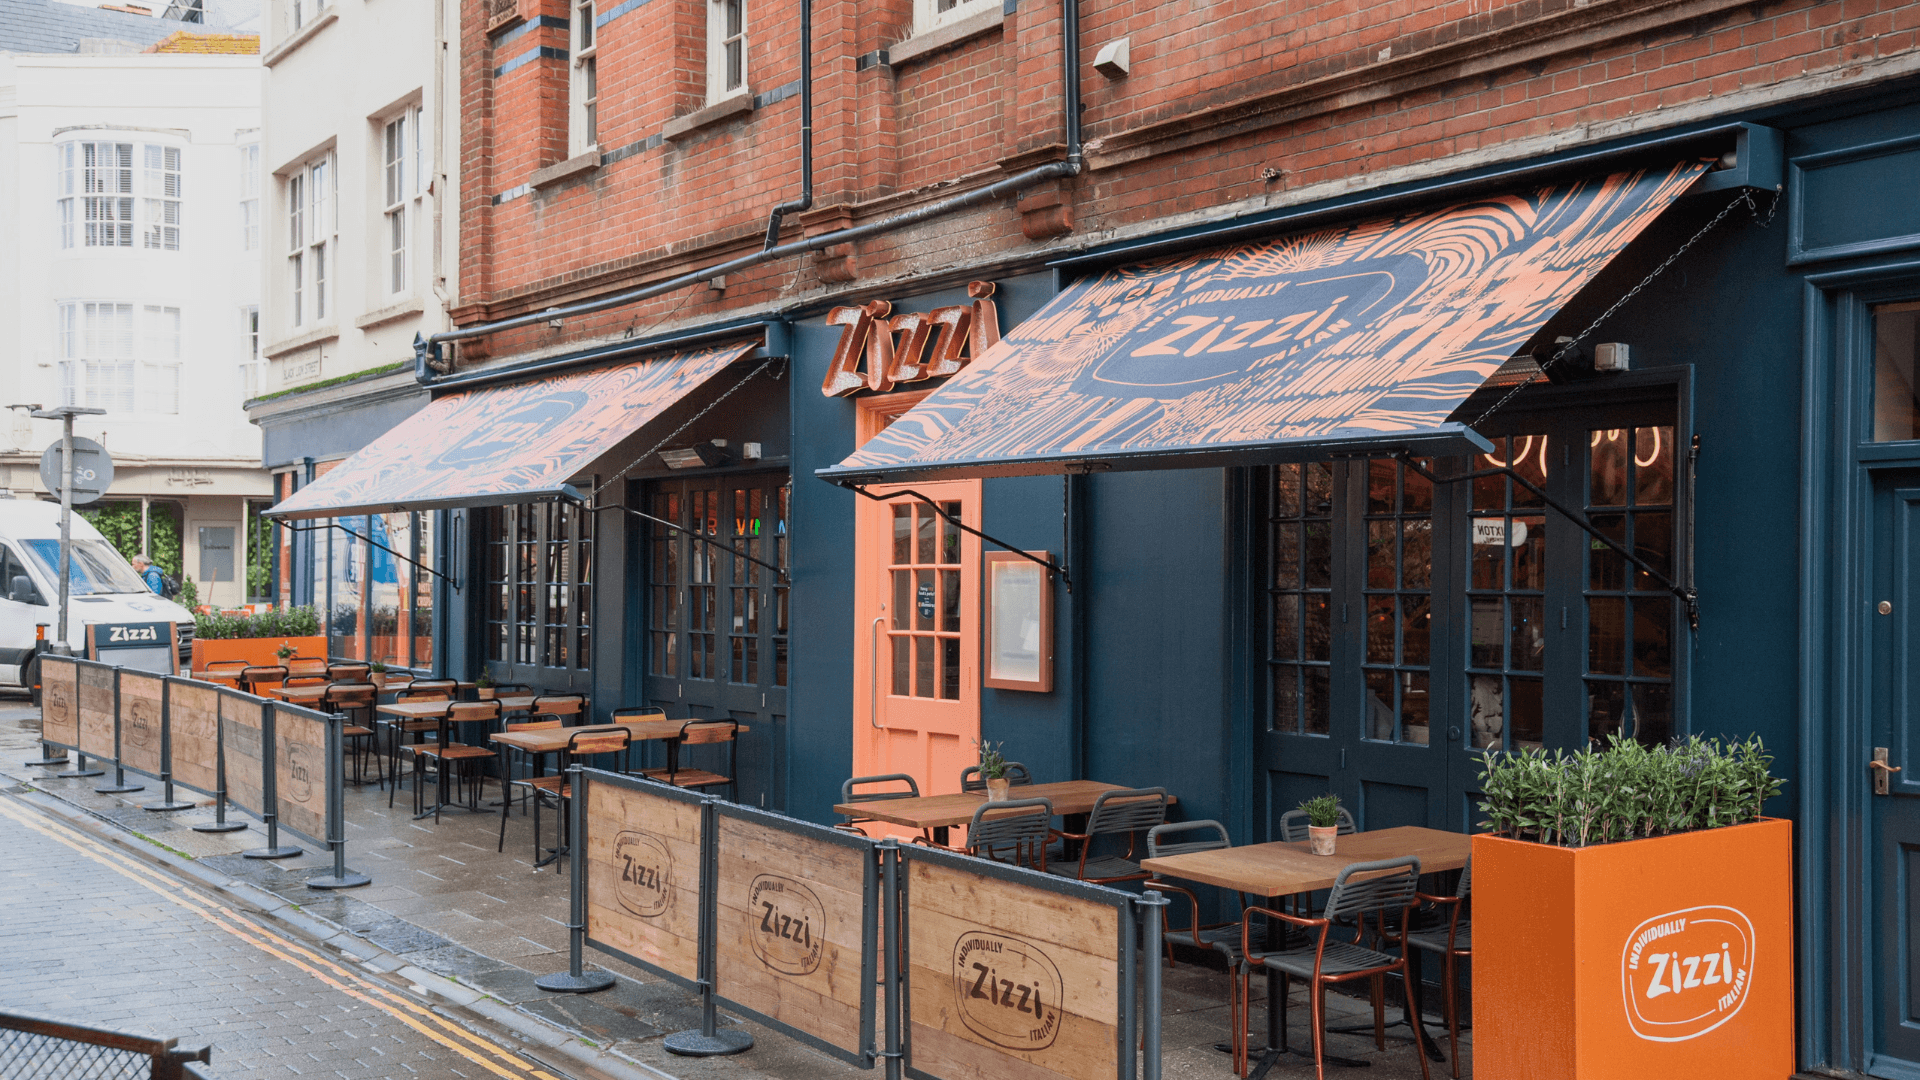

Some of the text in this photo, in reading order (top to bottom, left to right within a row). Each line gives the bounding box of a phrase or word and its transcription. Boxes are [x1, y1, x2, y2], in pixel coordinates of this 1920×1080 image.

[822, 280, 1001, 398] Zizzi
[1130, 295, 1349, 358] Zizzi
[1246, 318, 1352, 372] ITALIAN
[109, 625, 158, 642] Zizzi
[291, 760, 309, 783] Zizzi
[622, 854, 661, 894] Zizzi
[752, 880, 784, 906] INDIVIDUALLY
[760, 900, 811, 949] Zizzi
[1628, 918, 1686, 970] INDIVIDUALLY
[800, 942, 819, 968] ITALIAN
[958, 939, 1003, 968] INDIVIDUALLY
[1646, 942, 1732, 999] Zizzi
[970, 962, 1043, 1020] Zizzi
[1717, 968, 1747, 1012] ITALIAN
[1029, 1011, 1056, 1042] ITALIAN
